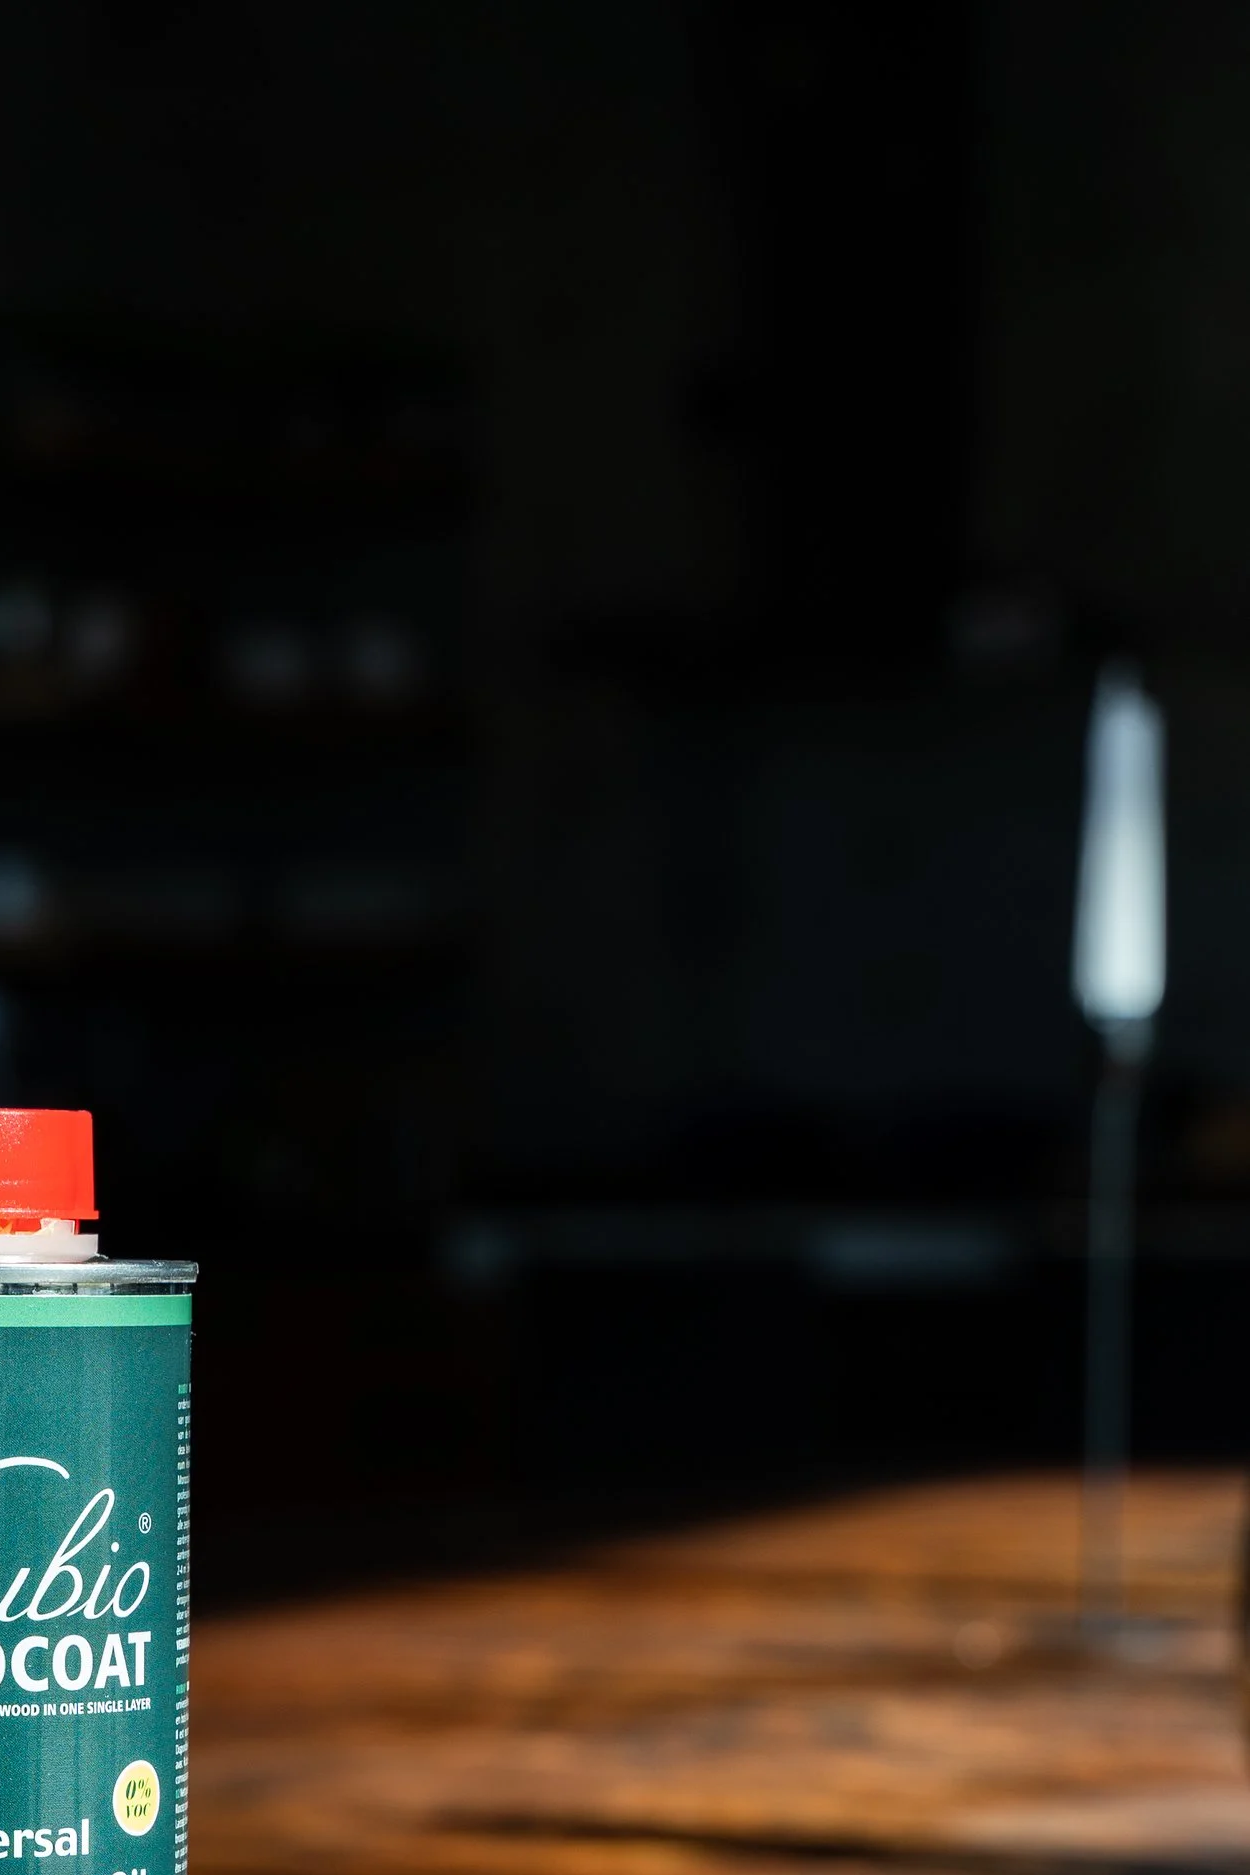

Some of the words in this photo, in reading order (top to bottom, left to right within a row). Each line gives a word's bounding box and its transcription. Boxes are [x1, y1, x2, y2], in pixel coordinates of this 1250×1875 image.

[43, 1702, 57, 1717] IN
[59, 1702, 85, 1716] ONE
[86, 1699, 124, 1715] SINGLE
[125, 1697, 152, 1713] LAYER
[125, 1777, 152, 1801] 0%
